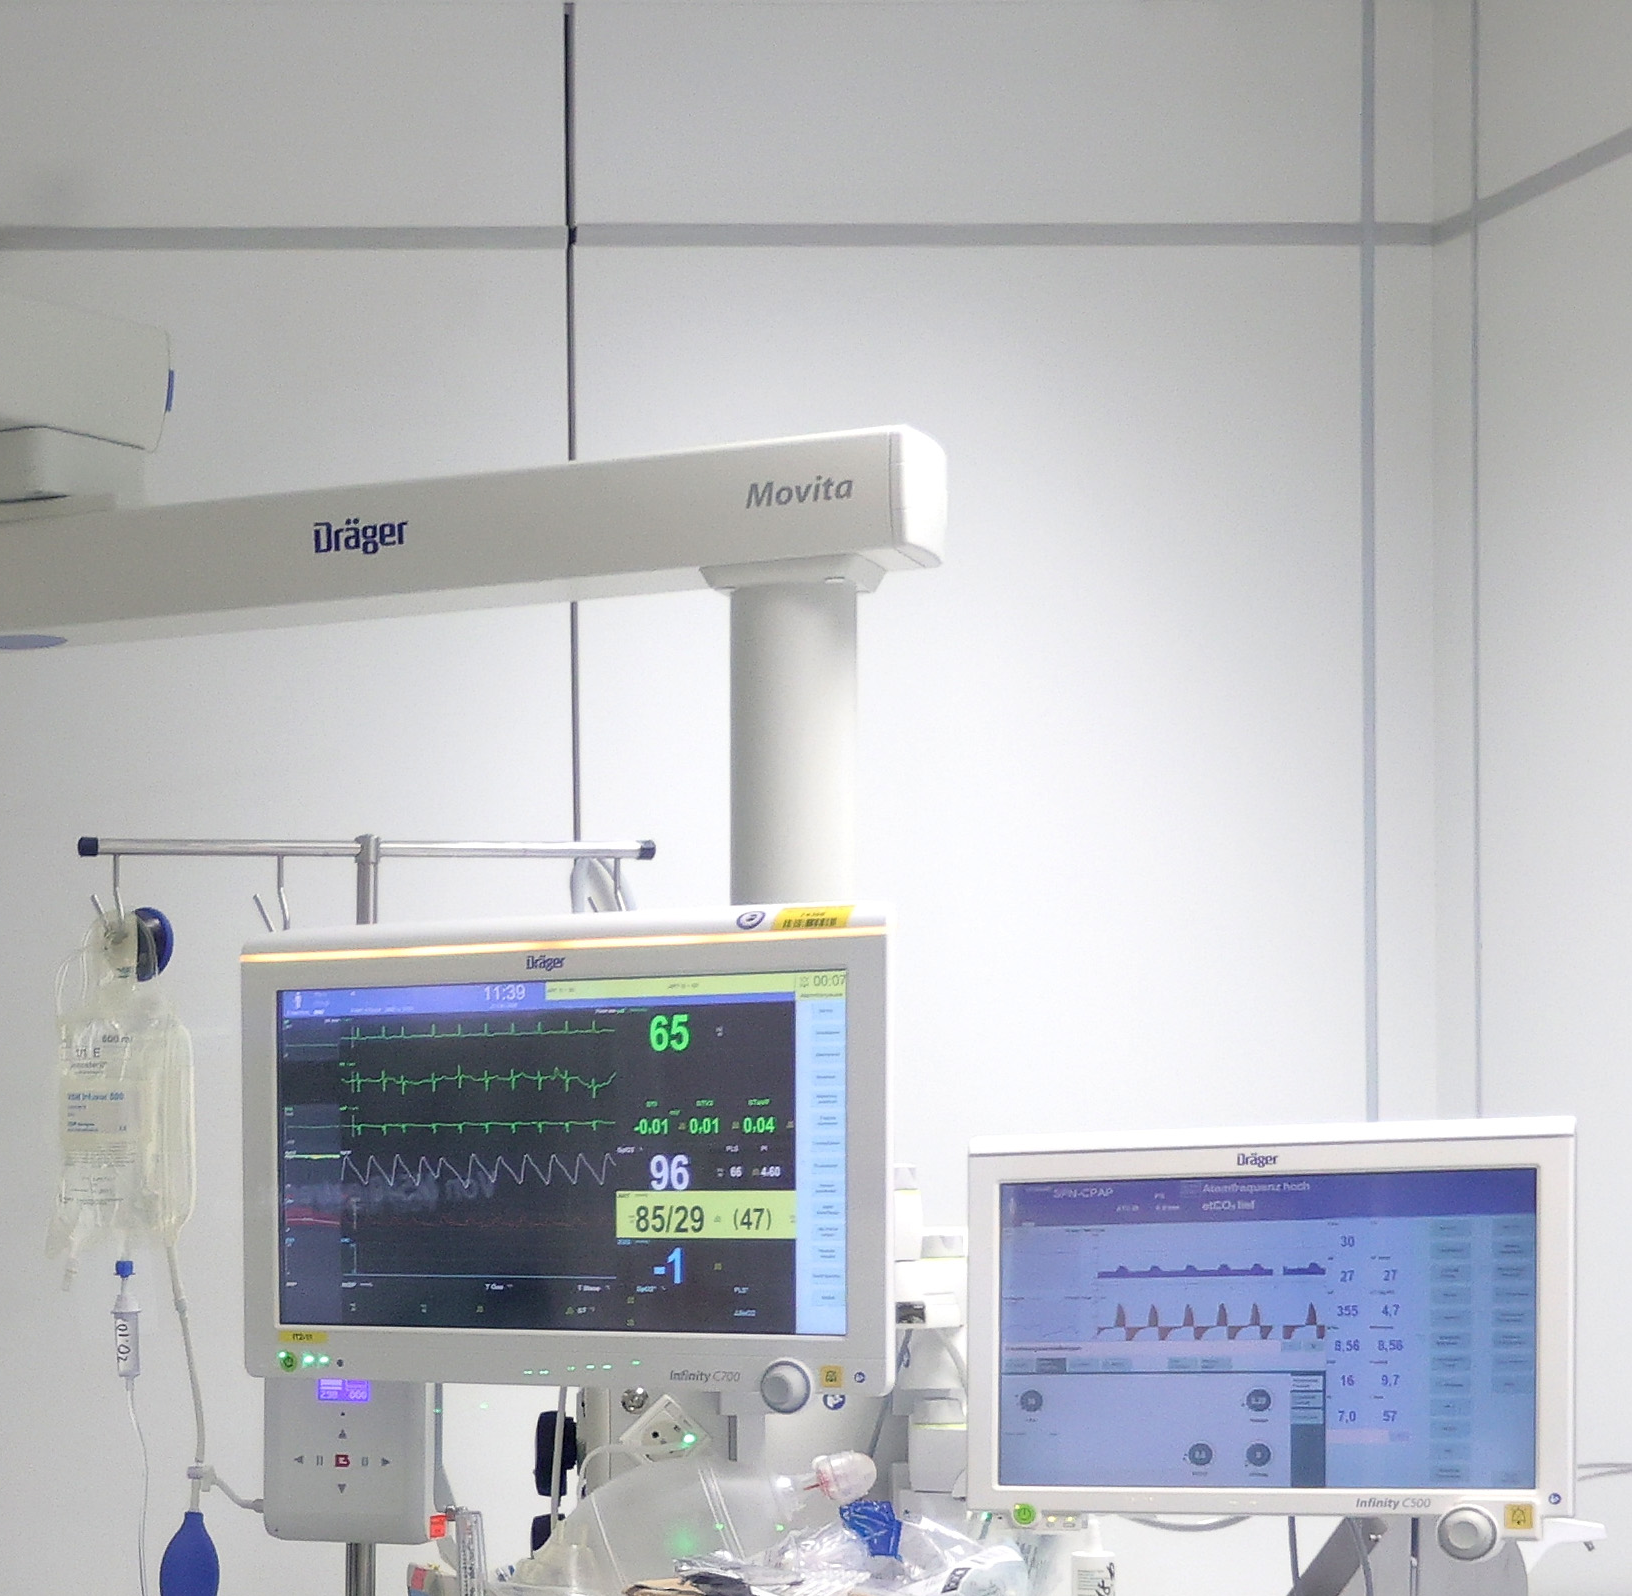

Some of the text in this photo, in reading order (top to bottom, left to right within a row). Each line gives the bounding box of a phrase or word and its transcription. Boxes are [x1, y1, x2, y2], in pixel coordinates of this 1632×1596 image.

[746, 475, 853, 509] Movita
[313, 517, 408, 555] Dräger
[525, 955, 566, 972] Dräger
[484, 983, 526, 1001] 11:39
[649, 1013, 690, 1051] 65
[1237, 1152, 1279, 1168] Dräger
[649, 1154, 690, 1191] 96
[636, 1205, 773, 1233] 85/29 (47)
[1340, 1236, 1355, 1247] 30
[653, 1246, 684, 1284] -1
[1340, 1270, 1355, 1282] 27
[1383, 1269, 1398, 1282] 27
[1337, 1304, 1359, 1317] 355
[669, 1368, 741, 1384] Infinity C700
[1340, 1375, 1355, 1387] 16
[1383, 1410, 1398, 1423] 57
[1356, 1497, 1431, 1510] Infinity C500
